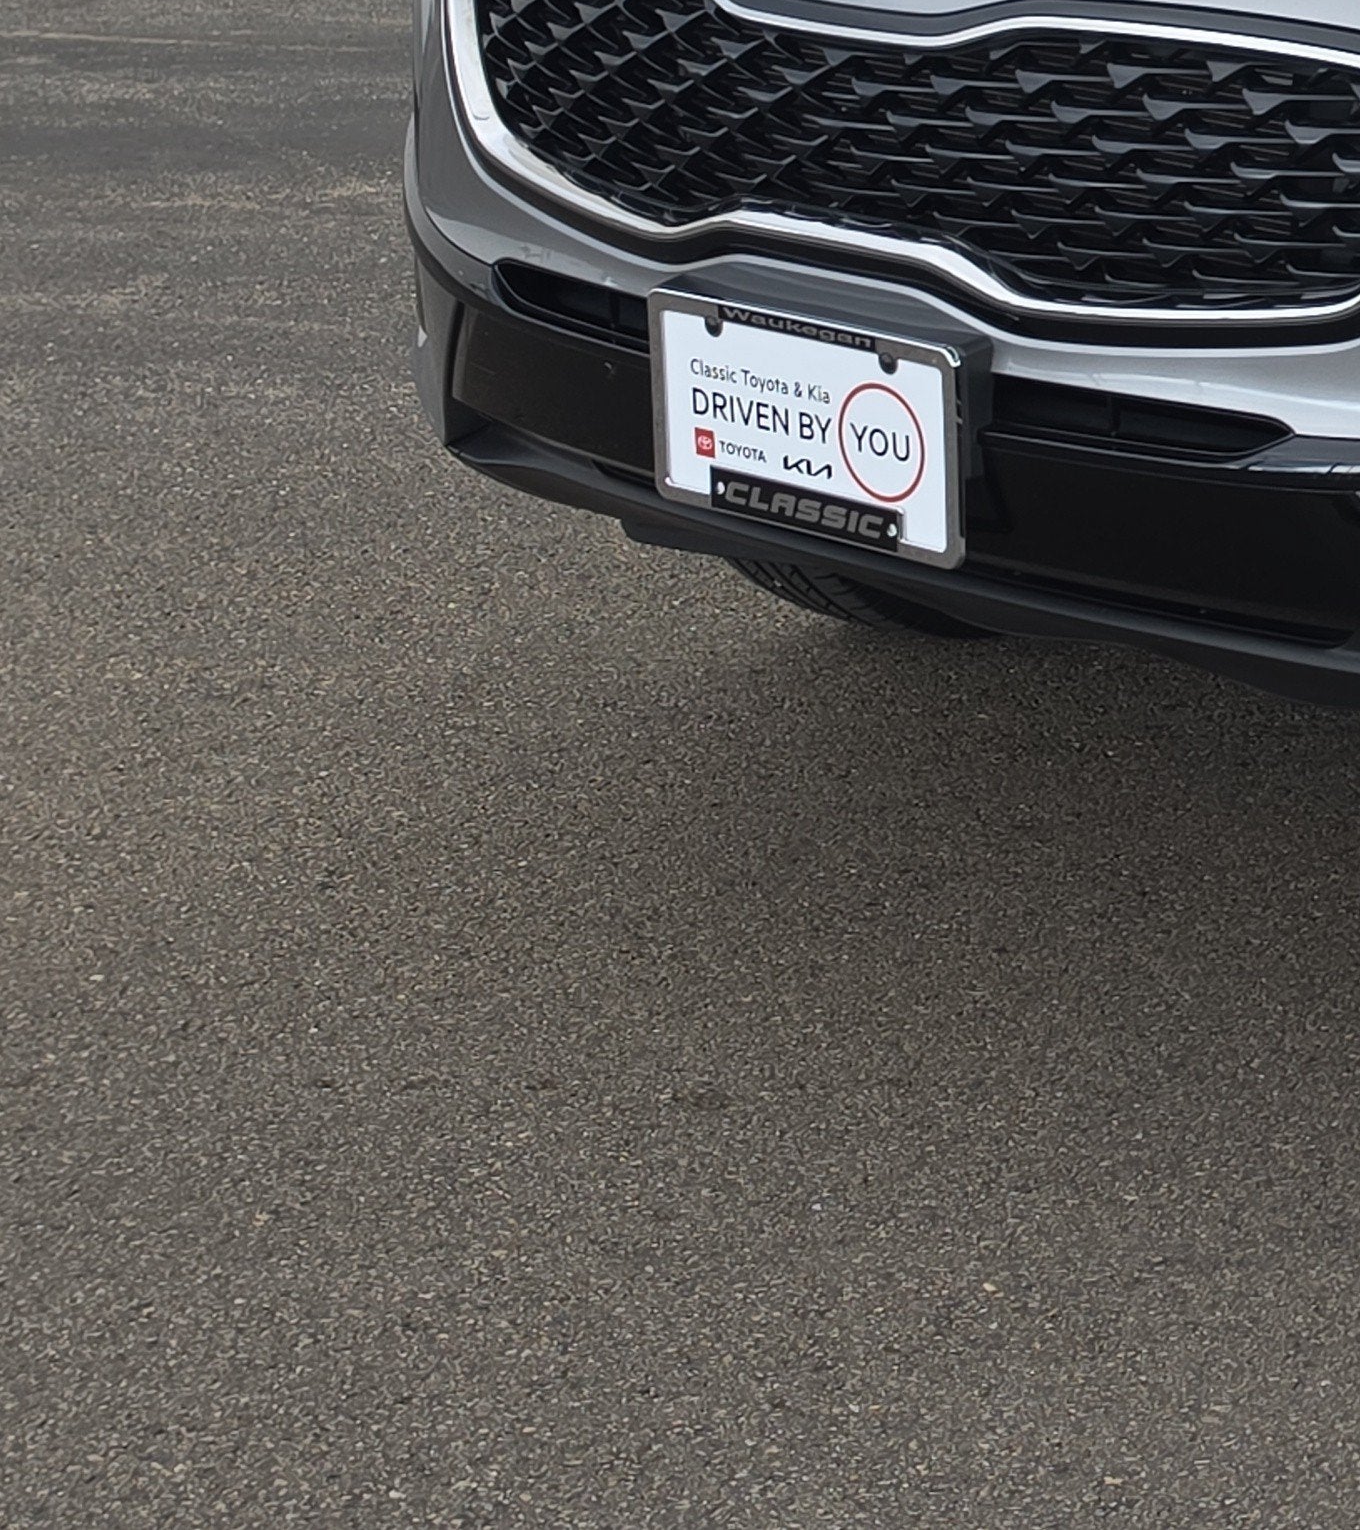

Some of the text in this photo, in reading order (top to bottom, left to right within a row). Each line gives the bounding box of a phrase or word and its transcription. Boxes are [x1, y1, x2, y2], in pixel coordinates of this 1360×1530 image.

[722, 306, 871, 348] Waukegan
[690, 358, 831, 404] Classic Toyota & Kia
[692, 387, 911, 461] DRIVEN BY YOU
[719, 440, 767, 463] TOYOTA
[724, 480, 886, 539] CLASSIC
